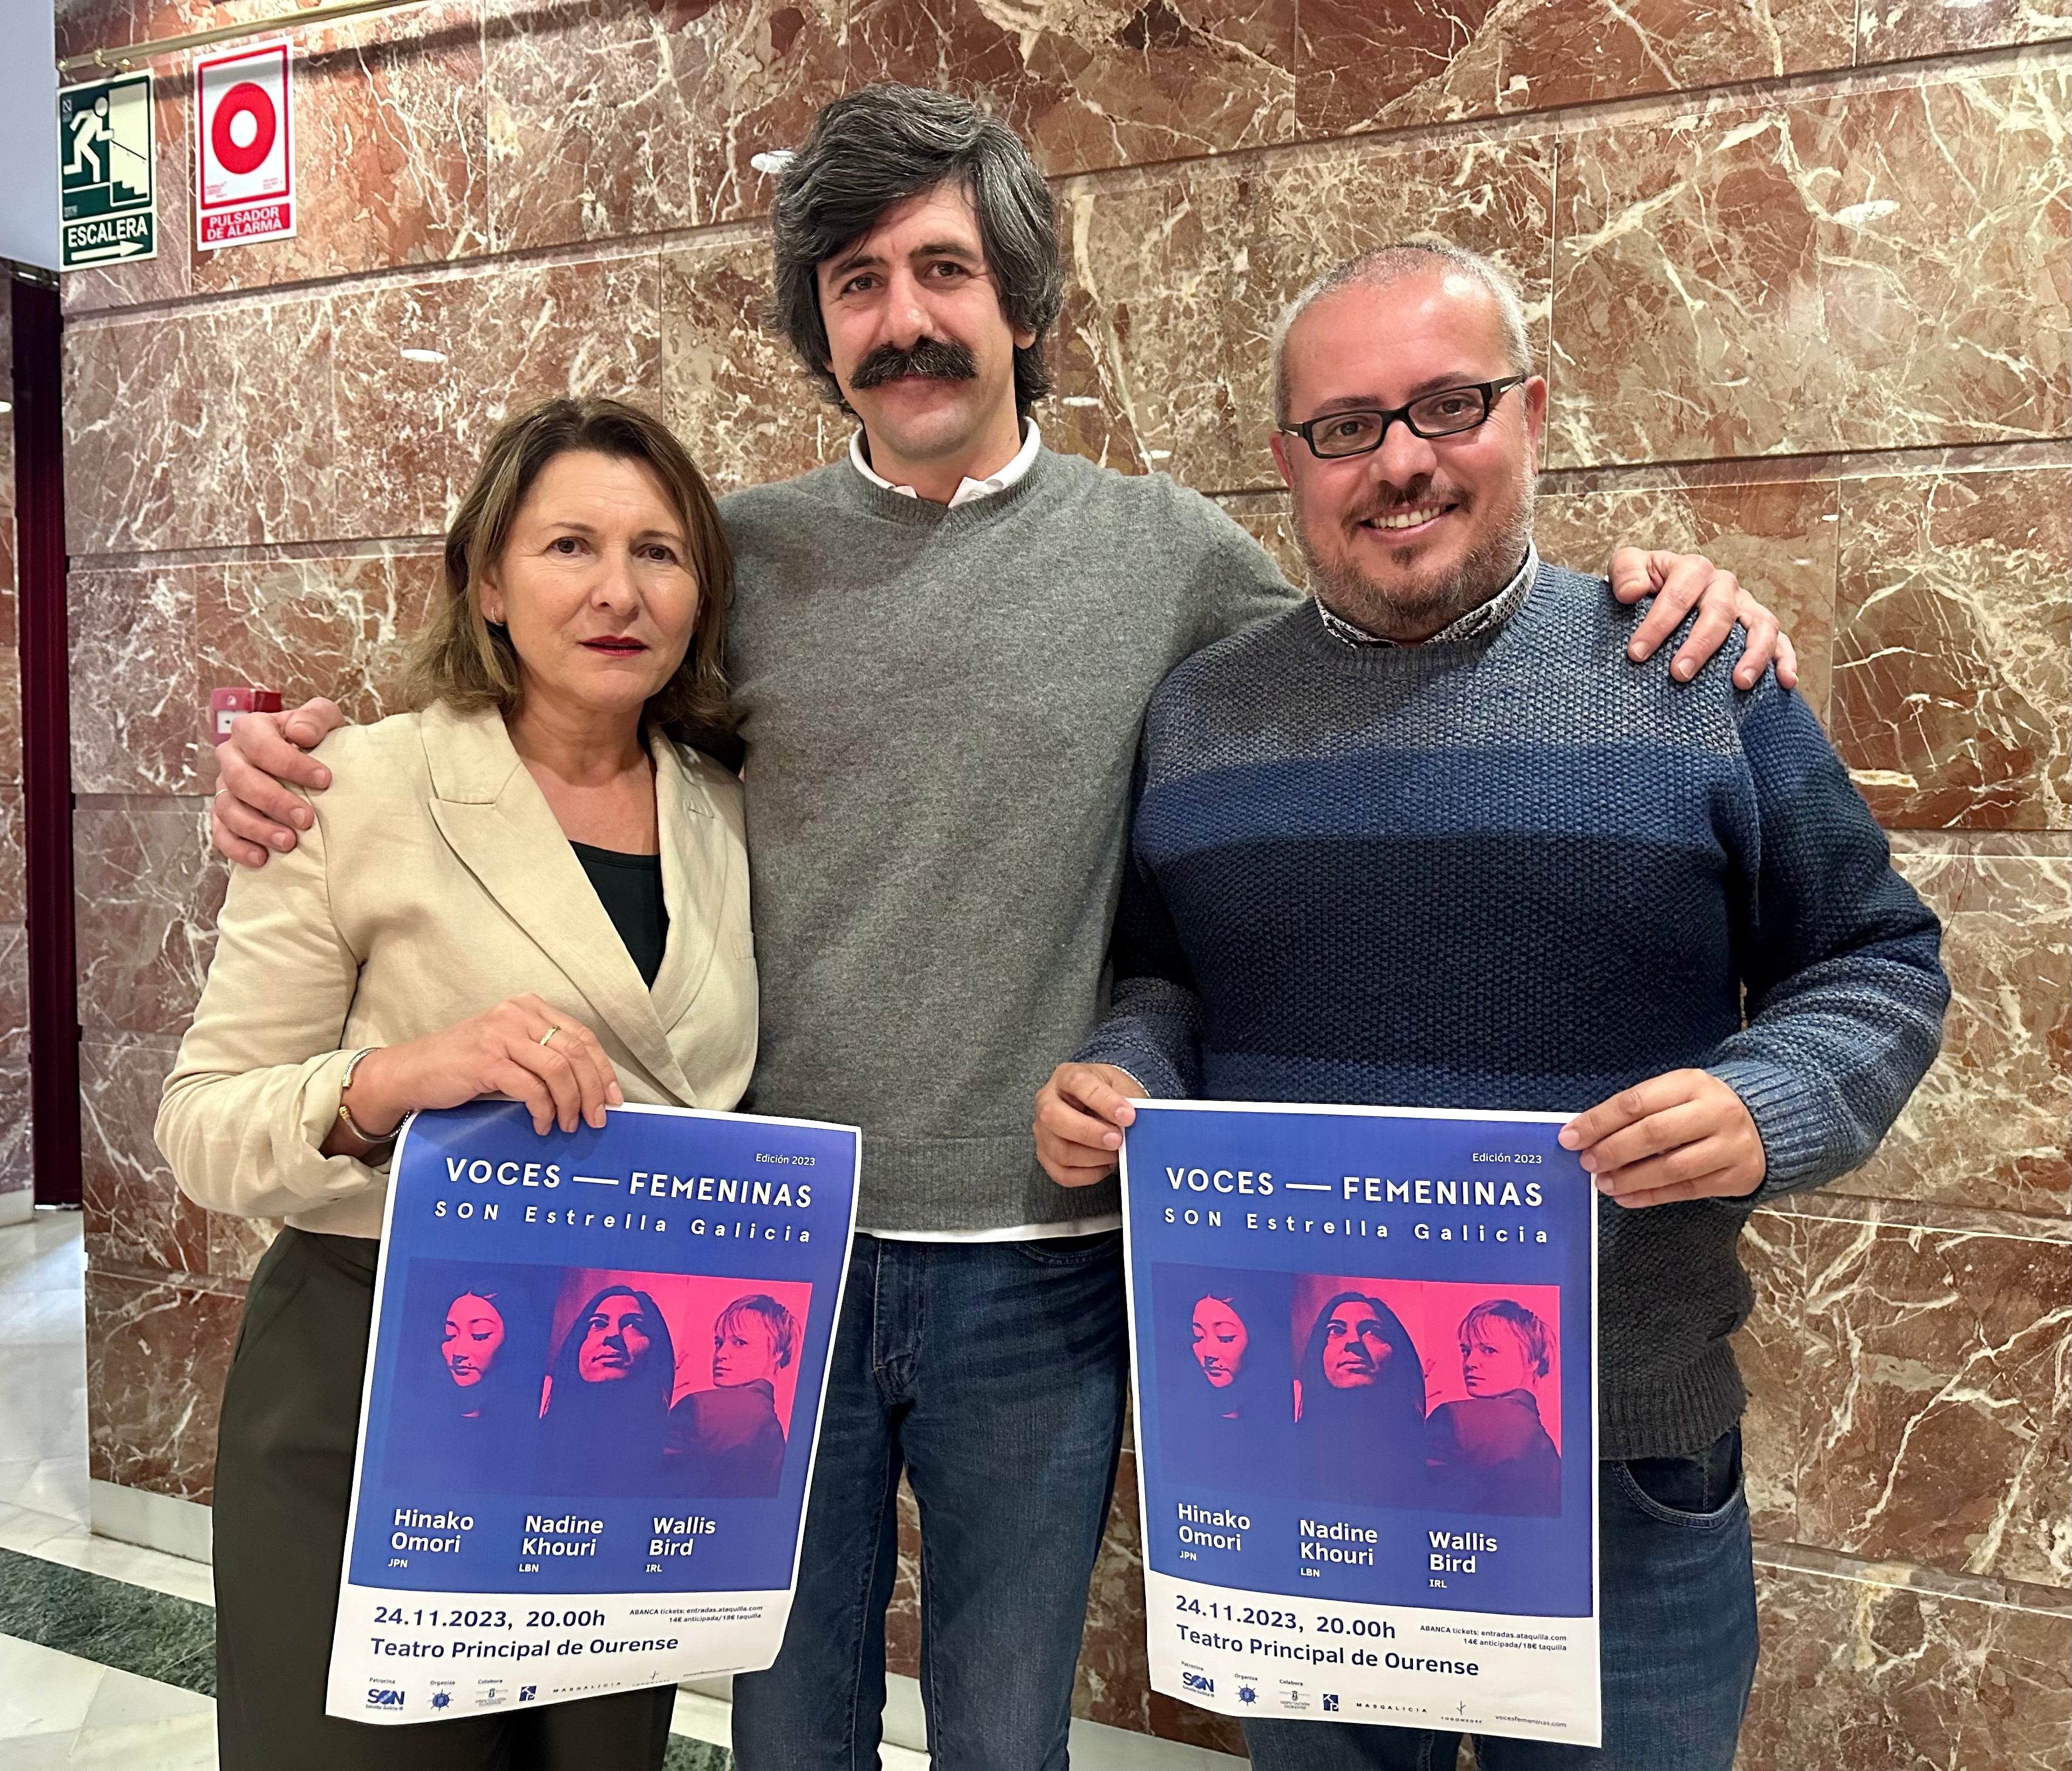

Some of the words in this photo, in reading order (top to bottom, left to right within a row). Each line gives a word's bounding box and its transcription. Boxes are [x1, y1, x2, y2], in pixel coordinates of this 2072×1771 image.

[209, 206, 280, 228] PULSADOR
[67, 217, 148, 248] ESCALERA
[207, 227, 224, 241] DE
[227, 217, 282, 237] ALARMA
[756, 1153, 789, 1164] Edición
[791, 1155, 815, 1166] 2023
[1472, 1152, 1511, 1163] Edición
[1514, 1154, 1542, 1164] 2023
[446, 1157, 561, 1188] VOCES
[630, 1172, 811, 1208] FEMENINAS
[1166, 1167, 1274, 1195] VOCES
[1343, 1177, 1542, 1206] FEMENINAS
[435, 1201, 499, 1220] SON
[525, 1206, 666, 1232] Estrella
[691, 1219, 810, 1243] Galicia
[1165, 1208, 1221, 1227] SON
[1247, 1213, 1388, 1237] Estrella
[1414, 1223, 1547, 1243] Galicia
[394, 1508, 474, 1530] Hinako
[525, 1515, 603, 1534] Nadine
[653, 1516, 716, 1534] Wallis
[1178, 1503, 1251, 1530] Hinako
[391, 1531, 461, 1553] Omori
[1179, 1525, 1241, 1551] Omori
[1300, 1519, 1378, 1544] Nadine
[1428, 1531, 1497, 1552] Wallis
[522, 1537, 596, 1556] Khouri
[649, 1538, 694, 1556] Bird
[1179, 1550, 1197, 1561] JPN
[1300, 1542, 1374, 1566] Khouri
[388, 1558, 408, 1568] JPN
[518, 1563, 540, 1572] LBN
[645, 1564, 663, 1573] IRL
[1300, 1567, 1320, 1578] LBN
[1430, 1553, 1476, 1573] Bird
[1429, 1579, 1448, 1588] IRL
[374, 1606, 513, 1630] 24.11.2023,
[526, 1609, 605, 1627] 20.00h
[1176, 1595, 1304, 1633] 24.11.2023,
[1316, 1616, 1395, 1639] 20.00h
[1420, 1625, 1451, 1633] ABANCA
[1480, 1630, 1567, 1642] entradas.ataquilla.com
[371, 1637, 445, 1658] Teatro
[452, 1640, 551, 1661] Principal
[557, 1639, 583, 1656] de
[590, 1639, 678, 1654] Ourense
[1176, 1623, 1243, 1653] Teatro
[1250, 1638, 1344, 1666] Principal
[1351, 1649, 1378, 1667] de
[1385, 1652, 1479, 1676] Ourense
[1479, 1639, 1537, 1650] anticipada/18€
[1234, 1673, 1258, 1681] Organiza
[1495, 1715, 1567, 1728] vocesfemeninas.com
